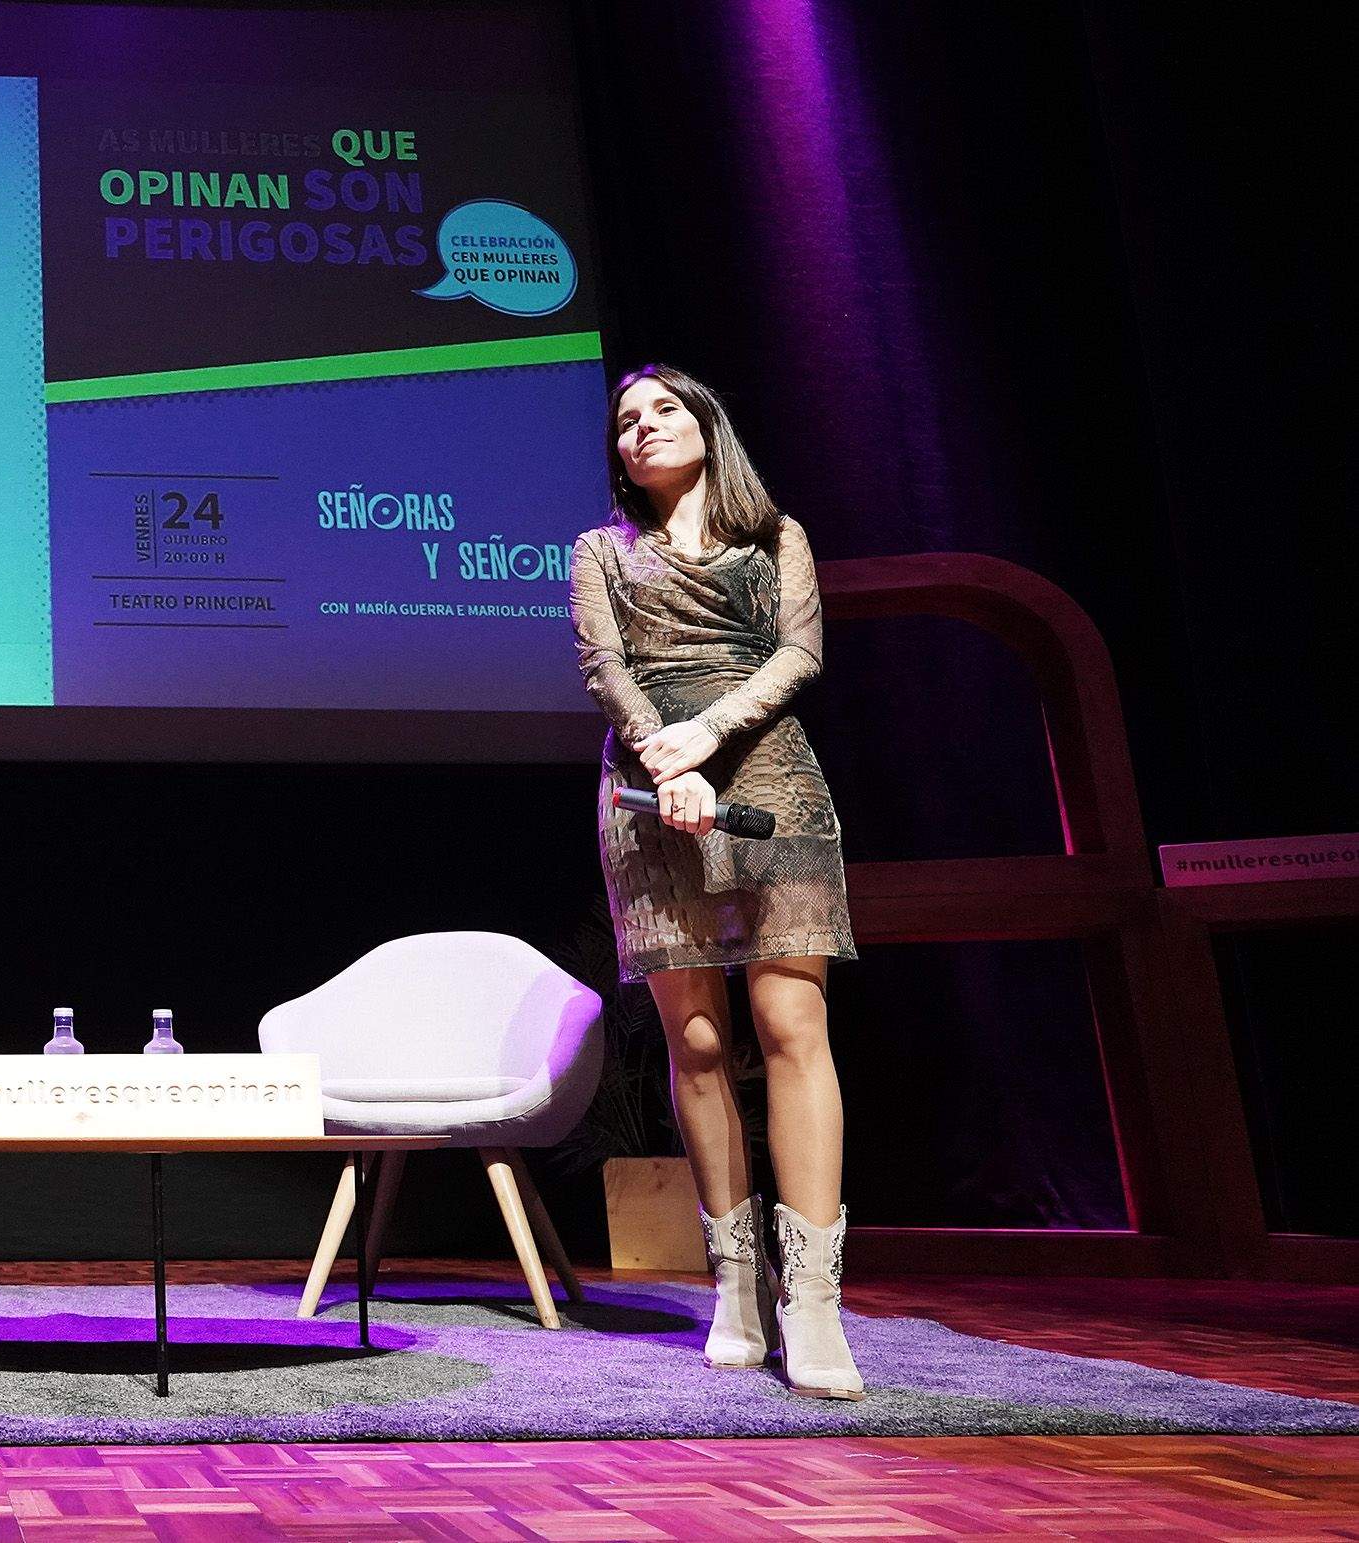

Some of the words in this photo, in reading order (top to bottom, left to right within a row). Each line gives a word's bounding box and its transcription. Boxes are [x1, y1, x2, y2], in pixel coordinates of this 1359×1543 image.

[98, 128, 139, 152] AS
[148, 130, 323, 157] MULLERES
[332, 129, 418, 167] QUE
[99, 169, 291, 209] OPINAN
[303, 168, 424, 214] SON
[105, 216, 428, 266] PERIGOSAS
[450, 234, 556, 249] CELEBRACIÓN
[451, 251, 479, 263] CEN
[483, 252, 559, 265] MULLERES
[454, 268, 490, 285] QUE
[494, 269, 561, 284] OPINAN
[160, 491, 225, 530] 24
[317, 483, 456, 531] SEÑORAS
[135, 493, 151, 563] VENRES
[163, 535, 228, 546] OUTUBRO
[164, 551, 210, 564] 20:00
[215, 552, 226, 564] H
[422, 542, 440, 580] Y
[109, 594, 178, 610] TEATRO
[183, 594, 276, 611] PRINCIPAL
[320, 602, 349, 615] CON
[355, 600, 397, 615] MARÍA
[400, 603, 454, 616] GUERRA
[456, 604, 464, 616] E
[467, 604, 528, 617] MARIOLA
[1176, 849, 1359, 872] #mulleresqueo
